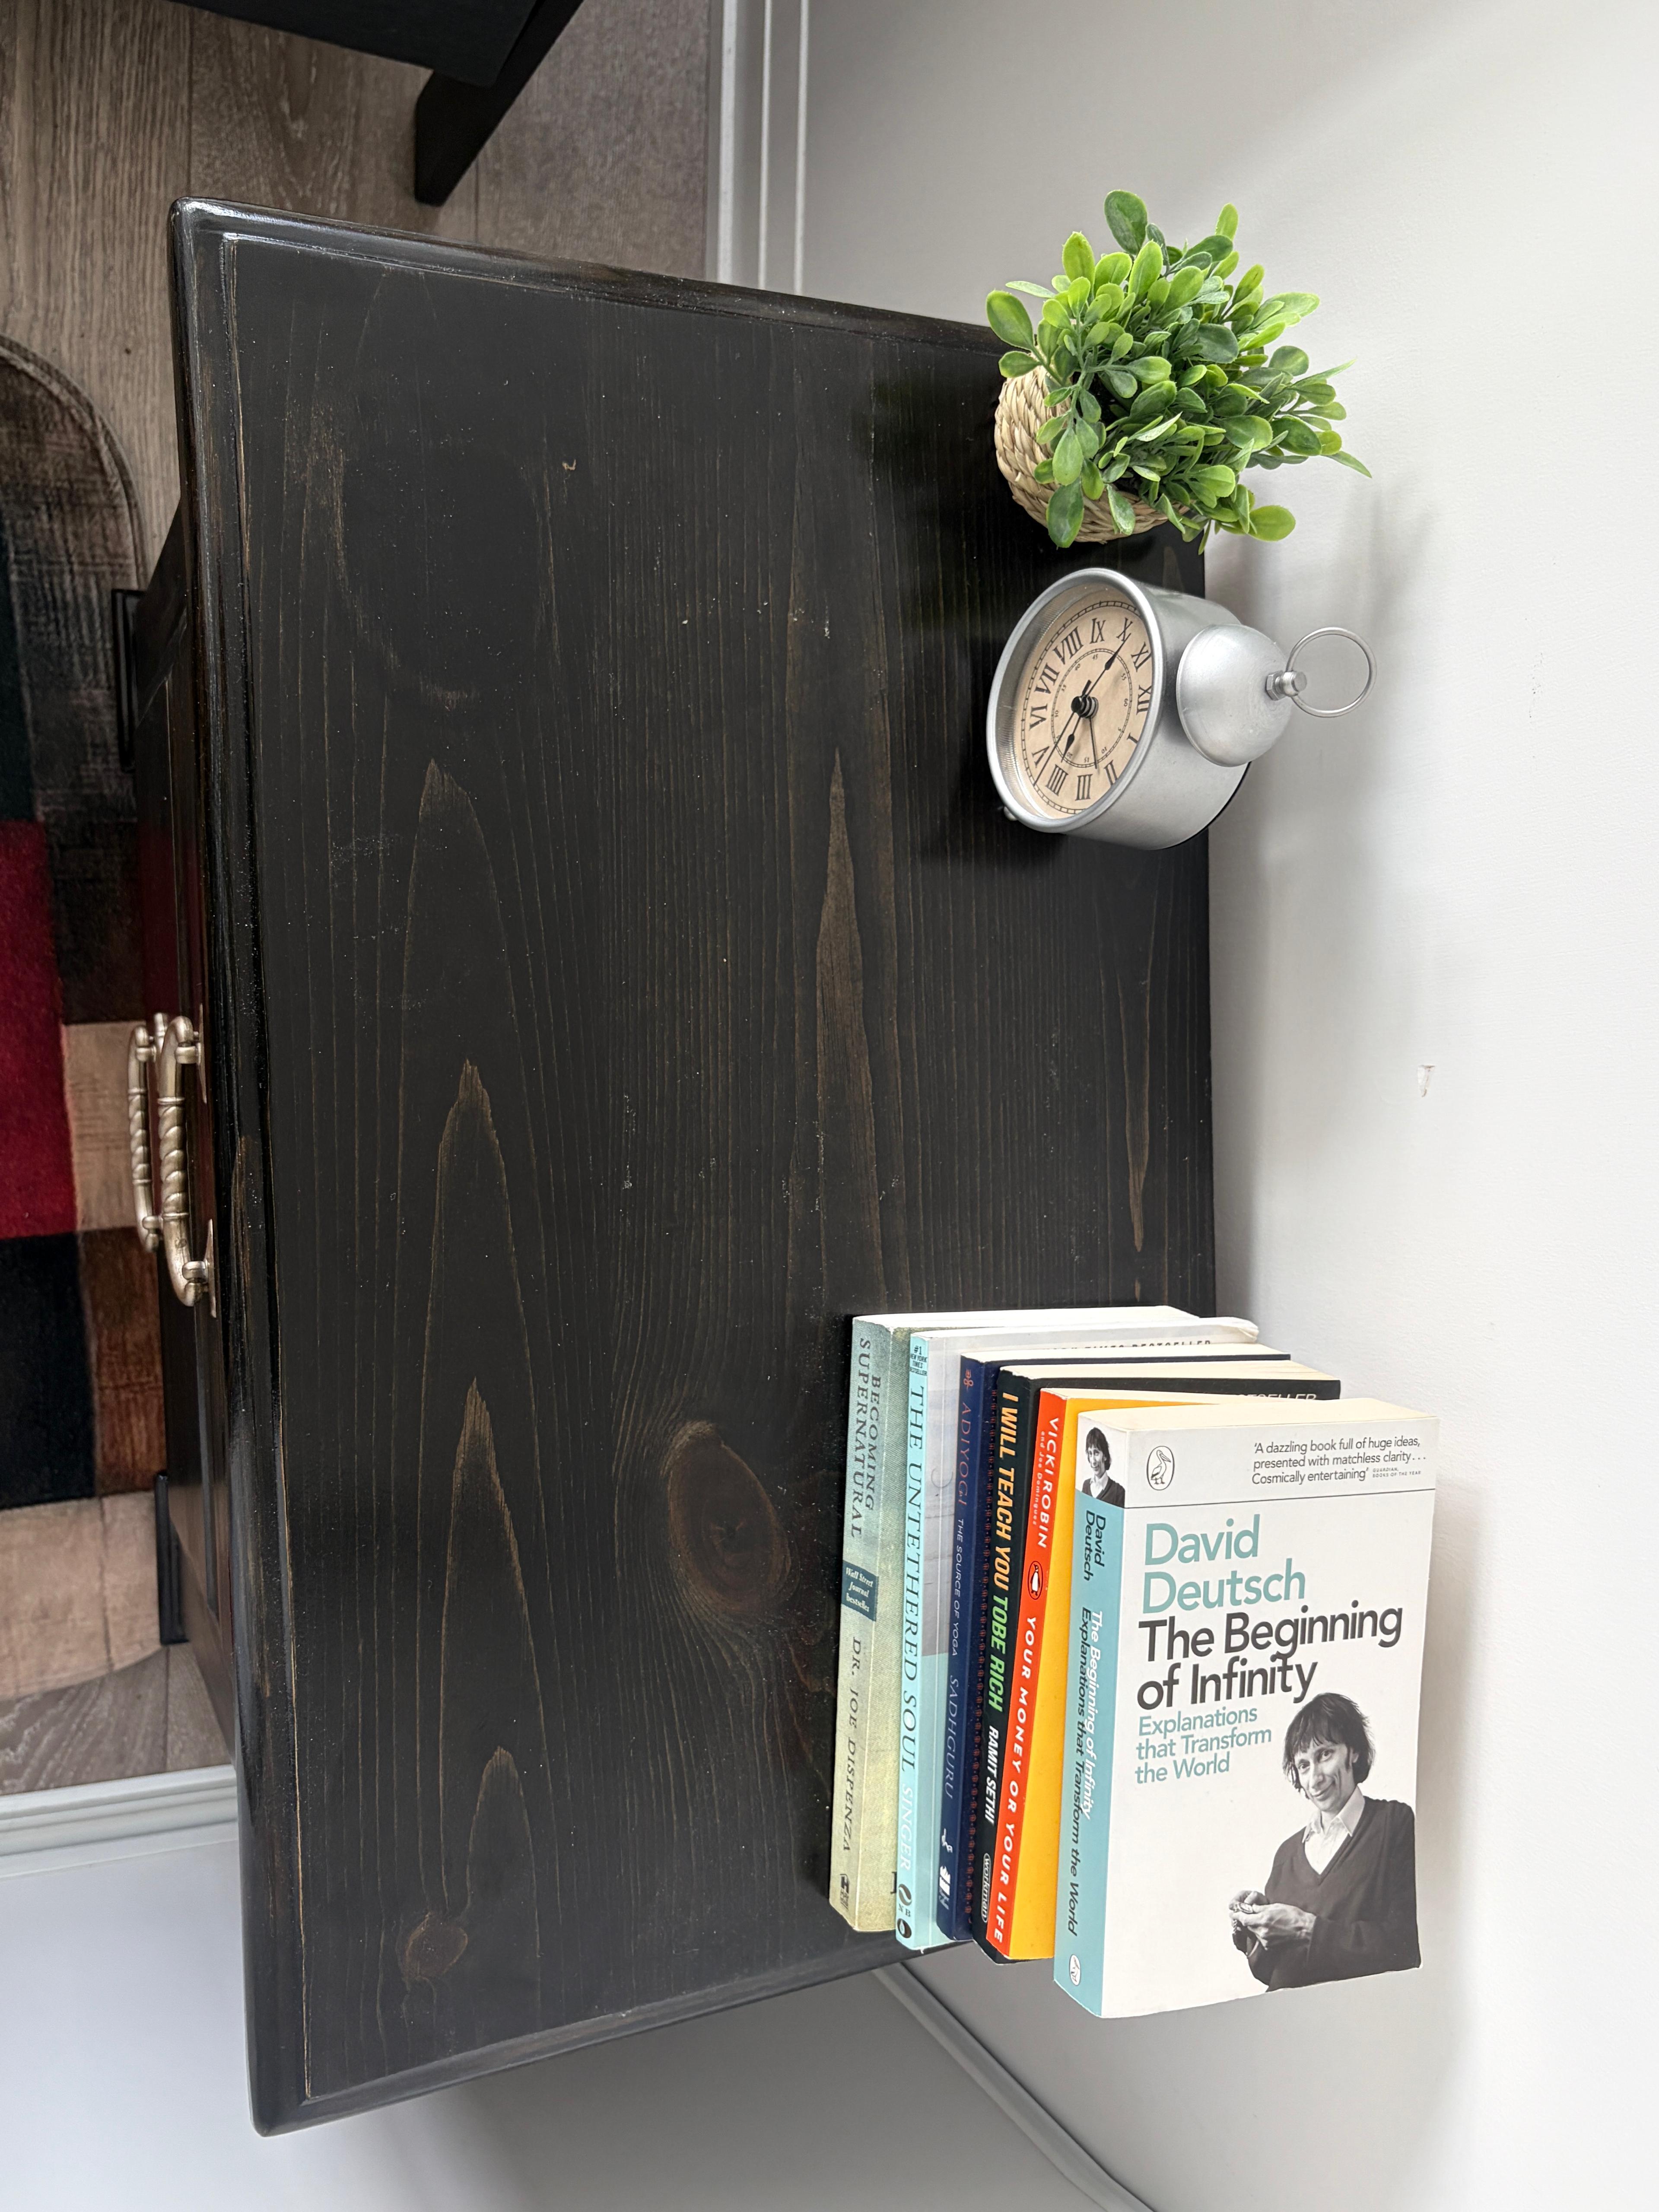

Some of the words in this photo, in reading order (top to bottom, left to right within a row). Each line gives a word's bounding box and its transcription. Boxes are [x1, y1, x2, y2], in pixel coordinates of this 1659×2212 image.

[1053, 626, 1084, 665] VIII
[1090, 617, 1106, 644] IX
[1034, 662, 1060, 694] VII
[1131, 642, 1152, 672] XI
[1029, 703, 1047, 730] VI
[1136, 685, 1152, 715] XII
[1031, 746, 1049, 768] V
[1045, 764, 1068, 796] IIII
[1104, 760, 1118, 785] II
[1075, 774, 1093, 801] III
[914, 1346, 922, 1355] #1
[910, 1386, 924, 1449] THE
[1002, 1392, 1018, 1402] I
[851, 1338, 871, 1538] SUPERNATURAL
[865, 1375, 881, 1511] BECOMING
[958, 1402, 971, 1506] ADIYOGI
[1000, 1407, 1018, 1459] WILL
[1045, 1417, 1059, 1475] VICKI
[1266, 1441, 1307, 1454] dazzling
[1310, 1439, 1336, 1451] book
[1339, 1438, 1353, 1450] full
[1356, 1437, 1367, 1449] of
[1369, 1437, 1392, 1450] huge
[1394, 1435, 1421, 1447] ideas,
[1252, 1471, 1306, 1485] Cosmically
[1254, 1455, 1305, 1471] presented
[1308, 1454, 1329, 1466] with
[1332, 1452, 1380, 1466] matchless
[996, 1468, 1015, 1541] TEACH
[1033, 1472, 1042, 1526] Dominguez
[1038, 1480, 1052, 1548] ROBIN
[1084, 1510, 1095, 1581] Deutsch
[1094, 1515, 1106, 1567] David
[1145, 1514, 1260, 1565] David
[845, 1567, 859, 1580] Wall
[859, 1573, 874, 1587] Street
[849, 1582, 869, 1598] Journal
[904, 1462, 922, 1681] UNTETHERED
[954, 1546, 963, 1597] SOURCE
[994, 1546, 1011, 1591] YOU
[1143, 1558, 1305, 1614] Deutsch
[954, 1600, 960, 1619] OF
[1091, 1611, 1103, 1642] The
[1138, 1616, 1214, 1662] The
[1224, 1600, 1403, 1658] Beginning
[852, 1636, 861, 1675] DR.
[1022, 1617, 1036, 1679] YOUR
[1077, 1607, 1091, 1716] Explanations
[988, 1654, 1005, 1712] RICH
[1085, 1646, 1100, 1734] Beginning
[1137, 1663, 1181, 1710] of
[1191, 1655, 1319, 1704] Infinity
[849, 1688, 859, 1729] JOE
[902, 1691, 916, 1771] SOUL
[1012, 1686, 1028, 1773] MONEY
[1139, 1706, 1257, 1739] Explanations
[945, 1675, 959, 1799] SADHGURU
[986, 1726, 999, 1778] RAMIT
[1076, 1721, 1086, 1756] that
[1086, 1737, 1097, 1760] of
[1136, 1738, 1176, 1760] that
[1181, 1726, 1271, 1754] Transform
[1081, 1759, 1095, 1820] Infinity
[1135, 1762, 1167, 1784] the
[1173, 1751, 1230, 1779] World
[843, 1737, 856, 1851] DISPENZA
[985, 1777, 996, 1824] SETHI
[1007, 1780, 1018, 1813] OR
[1072, 1761, 1084, 1844] Transform
[899, 1783, 913, 1871] SINGER
[1000, 1823, 1015, 1885] YOUR
[1071, 1849, 1080, 1877] the
[982, 1857, 990, 1918] workman
[1068, 1882, 1079, 1936] World
[994, 1891, 1007, 1944] LIFE
